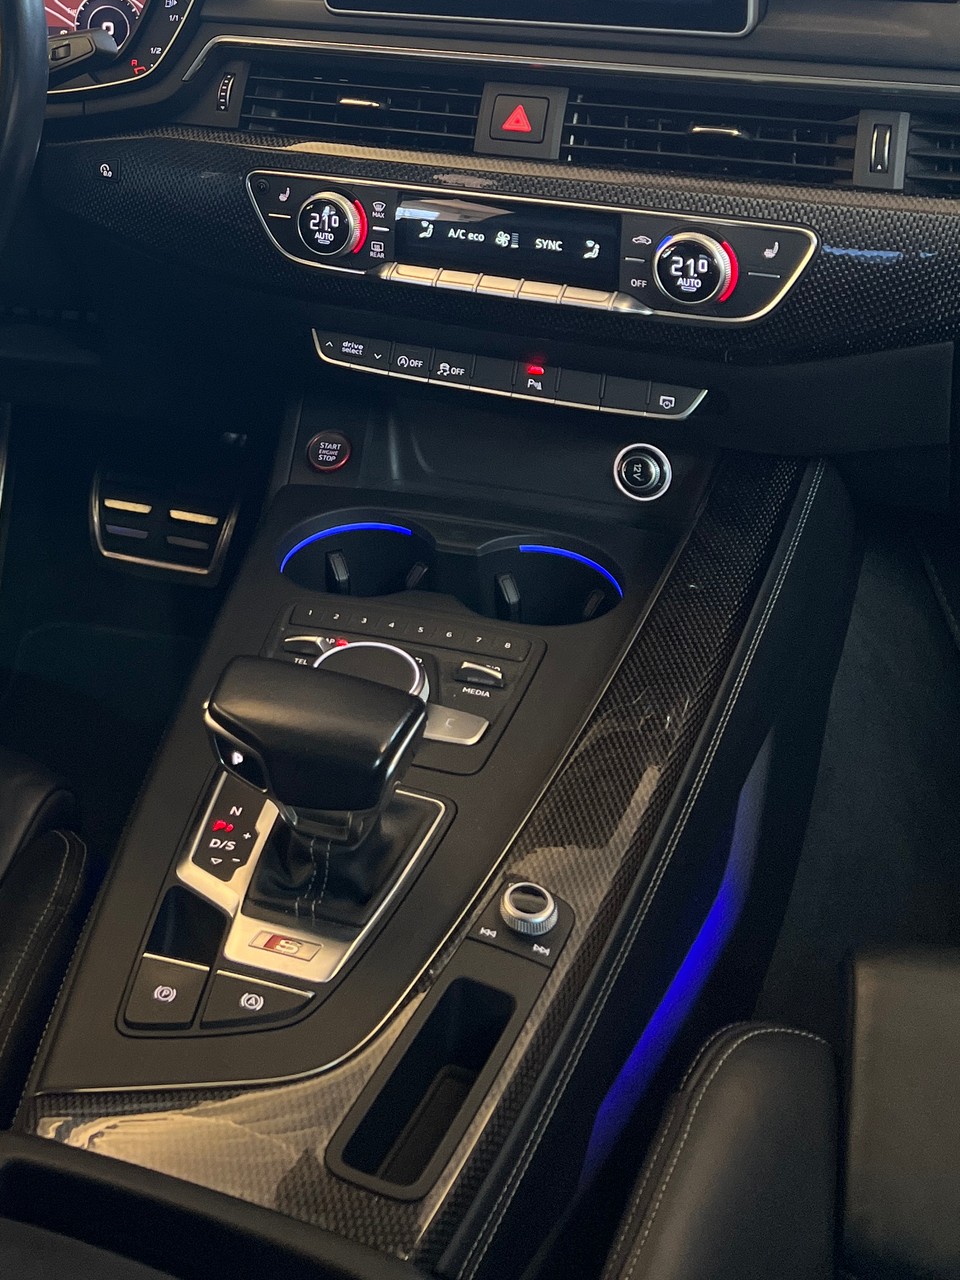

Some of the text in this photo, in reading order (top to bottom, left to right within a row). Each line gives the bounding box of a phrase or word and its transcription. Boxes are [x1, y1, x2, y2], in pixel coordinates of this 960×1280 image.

[169, 14, 179, 22] 1/1
[150, 47, 162, 55] 1/2
[371, 211, 385, 219] MAX
[314, 232, 335, 241] AUTO
[447, 227, 486, 242] A/C eco
[535, 237, 564, 252] SYNC
[369, 250, 385, 259] REAR
[630, 278, 648, 288] OFF
[676, 277, 702, 288] AUTO
[342, 340, 364, 350] drive
[341, 346, 363, 356] select
[409, 359, 424, 368] OFF
[450, 367, 465, 376] OFF
[319, 441, 342, 450] START
[317, 454, 337, 462] STOP
[632, 463, 645, 482] 12V
[293, 657, 308, 666] TEL
[461, 686, 491, 698] MEDIA
[229, 805, 243, 817] N
[208, 838, 237, 851] D/S
